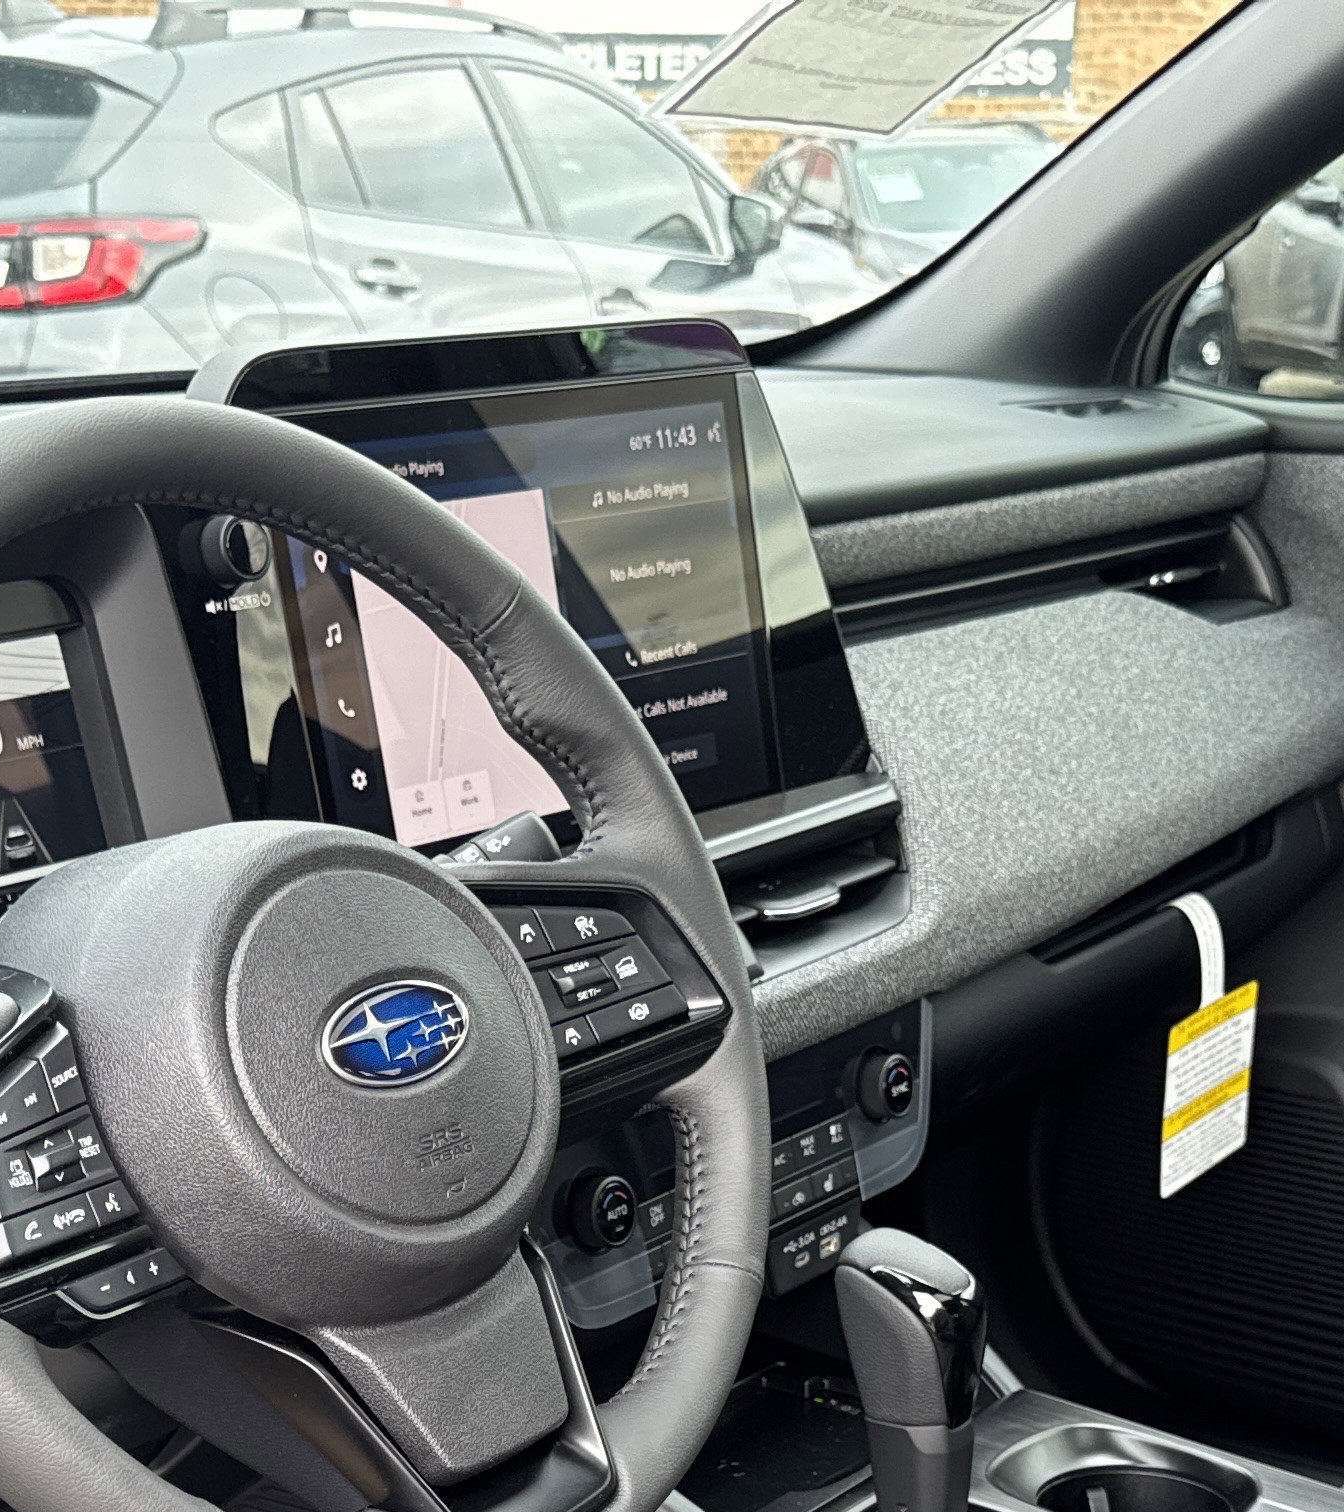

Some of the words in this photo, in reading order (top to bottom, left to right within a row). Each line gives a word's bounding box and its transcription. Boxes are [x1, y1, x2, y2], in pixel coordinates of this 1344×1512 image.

[656, 423, 697, 449] 11:43
[408, 460, 445, 478] Playing
[607, 490, 623, 504] No
[624, 485, 653, 502] Audio
[654, 481, 689, 500] Playing
[610, 568, 626, 582] No
[627, 562, 655, 579] Audio
[656, 557, 692, 578] Playing
[641, 645, 674, 664] Recent
[675, 640, 697, 657] Calls
[644, 700, 666, 718] Calls
[667, 696, 686, 713] Not
[687, 685, 728, 708] Available
[16, 733, 44, 751] MPH
[671, 749, 698, 765] Device
[419, 1124, 464, 1151] SRS
[607, 1203, 628, 1221] AUTO
